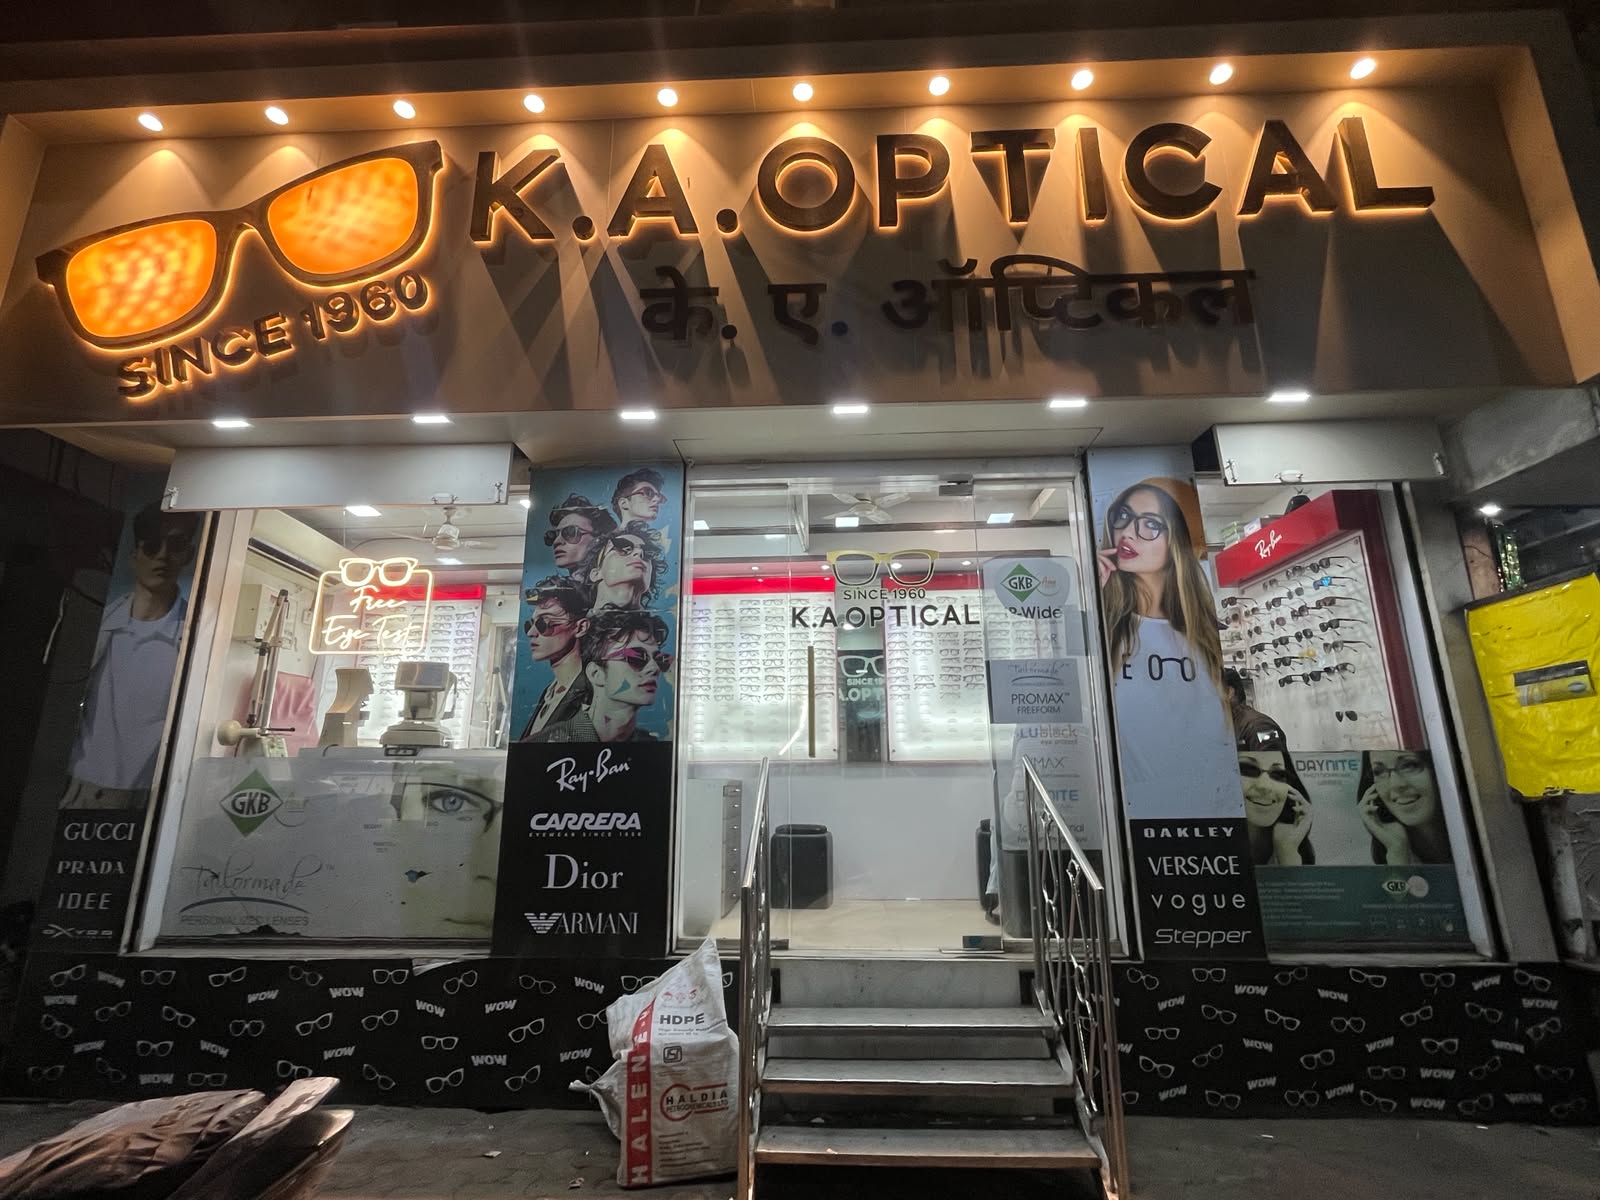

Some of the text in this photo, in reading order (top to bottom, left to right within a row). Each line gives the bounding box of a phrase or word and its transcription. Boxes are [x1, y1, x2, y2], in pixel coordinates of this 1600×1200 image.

[118, 269, 429, 399] SINCE 1960
[1008, 576, 1034, 592] GKB
[350, 585, 408, 613] Free
[843, 588, 926, 600] SINCE 1960
[322, 615, 421, 649] Eye Test
[846, 677, 873, 686] SINCE
[1011, 693, 1064, 705] PROMAX
[1016, 704, 1061, 715] FREEFORM
[1015, 724, 1078, 738] LUblock
[230, 790, 271, 815] GKB
[530, 812, 642, 831] CARRERA
[63, 822, 137, 841] GUCCI
[1143, 826, 1234, 838] OAKLEY
[57, 860, 126, 875] PRADA
[542, 853, 624, 890] Dior
[1147, 855, 1241, 876] VERSACE
[57, 892, 113, 910] IDEE
[1151, 893, 1246, 916] vogue
[555, 912, 639, 934] ARMANI
[1154, 928, 1252, 949] Stepper
[574, 976, 605, 994] WOW
[1234, 984, 1268, 996] WOW
[1472, 974, 1501, 991] WOW
[248, 989, 279, 1003] WOW
[329, 987, 365, 999] WOW
[1317, 989, 1348, 1002] WOW
[415, 1000, 446, 1018] WOW
[484, 1000, 517, 1013] WOW
[1157, 995, 1185, 1011] WOW
[1521, 998, 1558, 1009] WOW
[660, 1012, 705, 1026] HDPE
[200, 1040, 229, 1058] WOW
[1242, 1038, 1273, 1051] WOW
[1365, 1036, 1395, 1053] WOW
[323, 1046, 355, 1060] WOW
[471, 1054, 507, 1066] WOW
[559, 1048, 592, 1062] WOW
[139, 1073, 173, 1085] WOW
[1420, 1067, 1456, 1080] WOW
[1247, 1077, 1277, 1090] WOW
[1325, 1083, 1355, 1099] WOW
[665, 1089, 728, 1105] HALDIA
[1158, 1085, 1188, 1101] WOW
[1410, 1098, 1446, 1110] WOW
